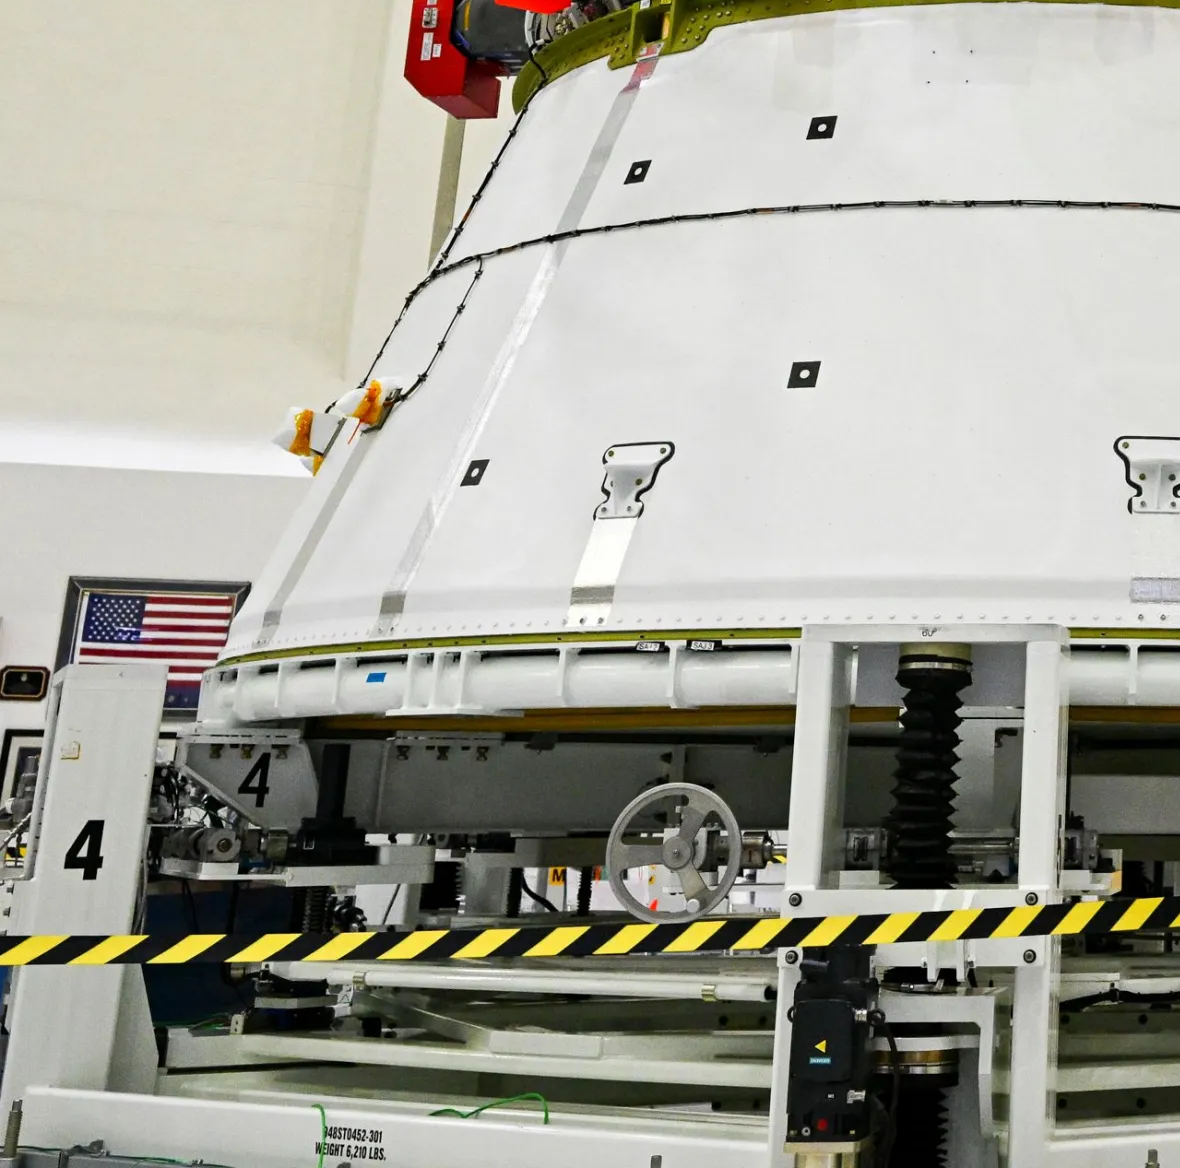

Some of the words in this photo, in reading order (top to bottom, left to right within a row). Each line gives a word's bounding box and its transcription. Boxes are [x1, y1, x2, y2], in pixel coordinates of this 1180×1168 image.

[238, 752, 272, 808] 4
[63, 819, 105, 880] 4
[315, 1142, 345, 1157] WEIGHT
[346, 1144, 367, 1160] 6,210
